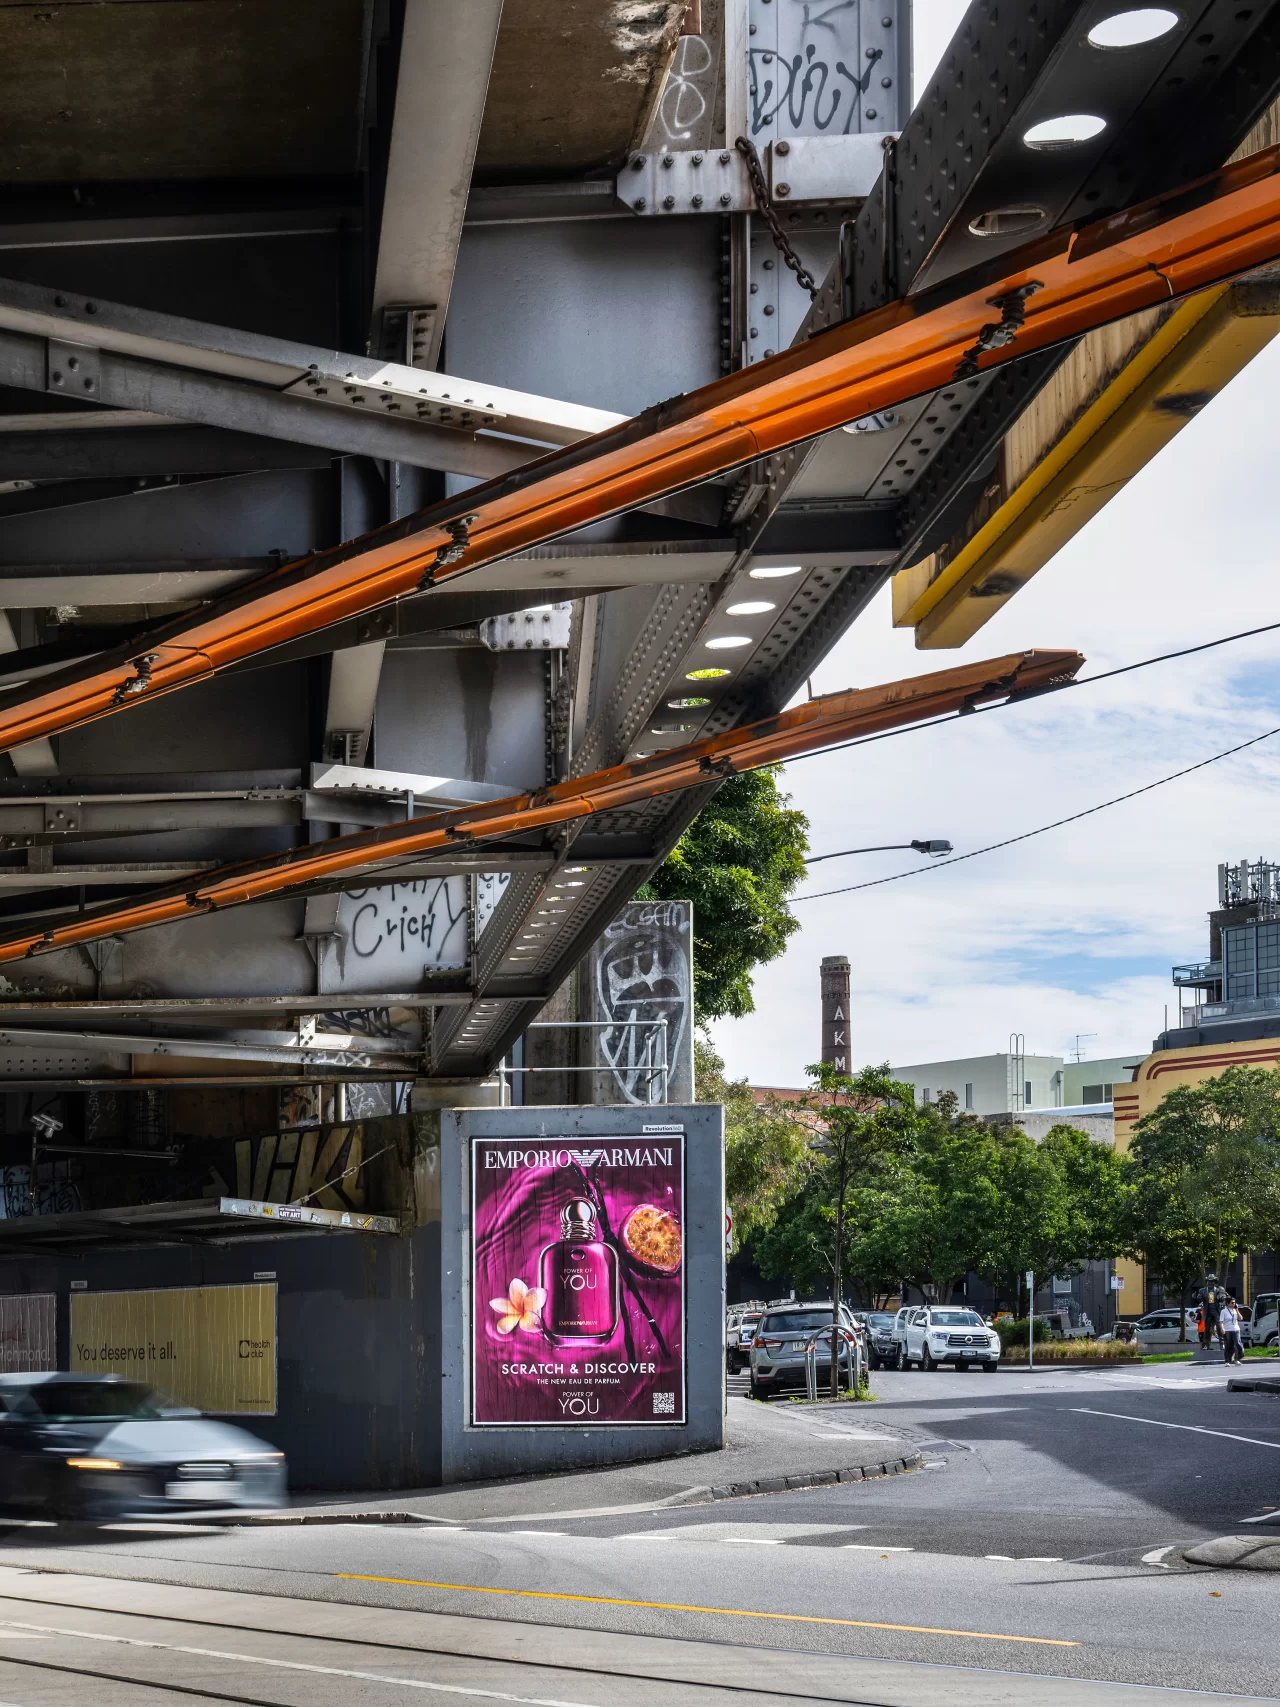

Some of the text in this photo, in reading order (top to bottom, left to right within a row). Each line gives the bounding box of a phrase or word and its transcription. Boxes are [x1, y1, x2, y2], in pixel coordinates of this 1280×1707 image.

[485, 1147, 673, 1169] EMPORIO ARMANI
[560, 1273, 597, 1290] YOU
[76, 1341, 177, 1362] You deserve it all.
[250, 1339, 271, 1349] health
[250, 1349, 264, 1358] club
[501, 1362, 656, 1374] SCRATCH & DISCOVER
[558, 1398, 599, 1415] YOU
